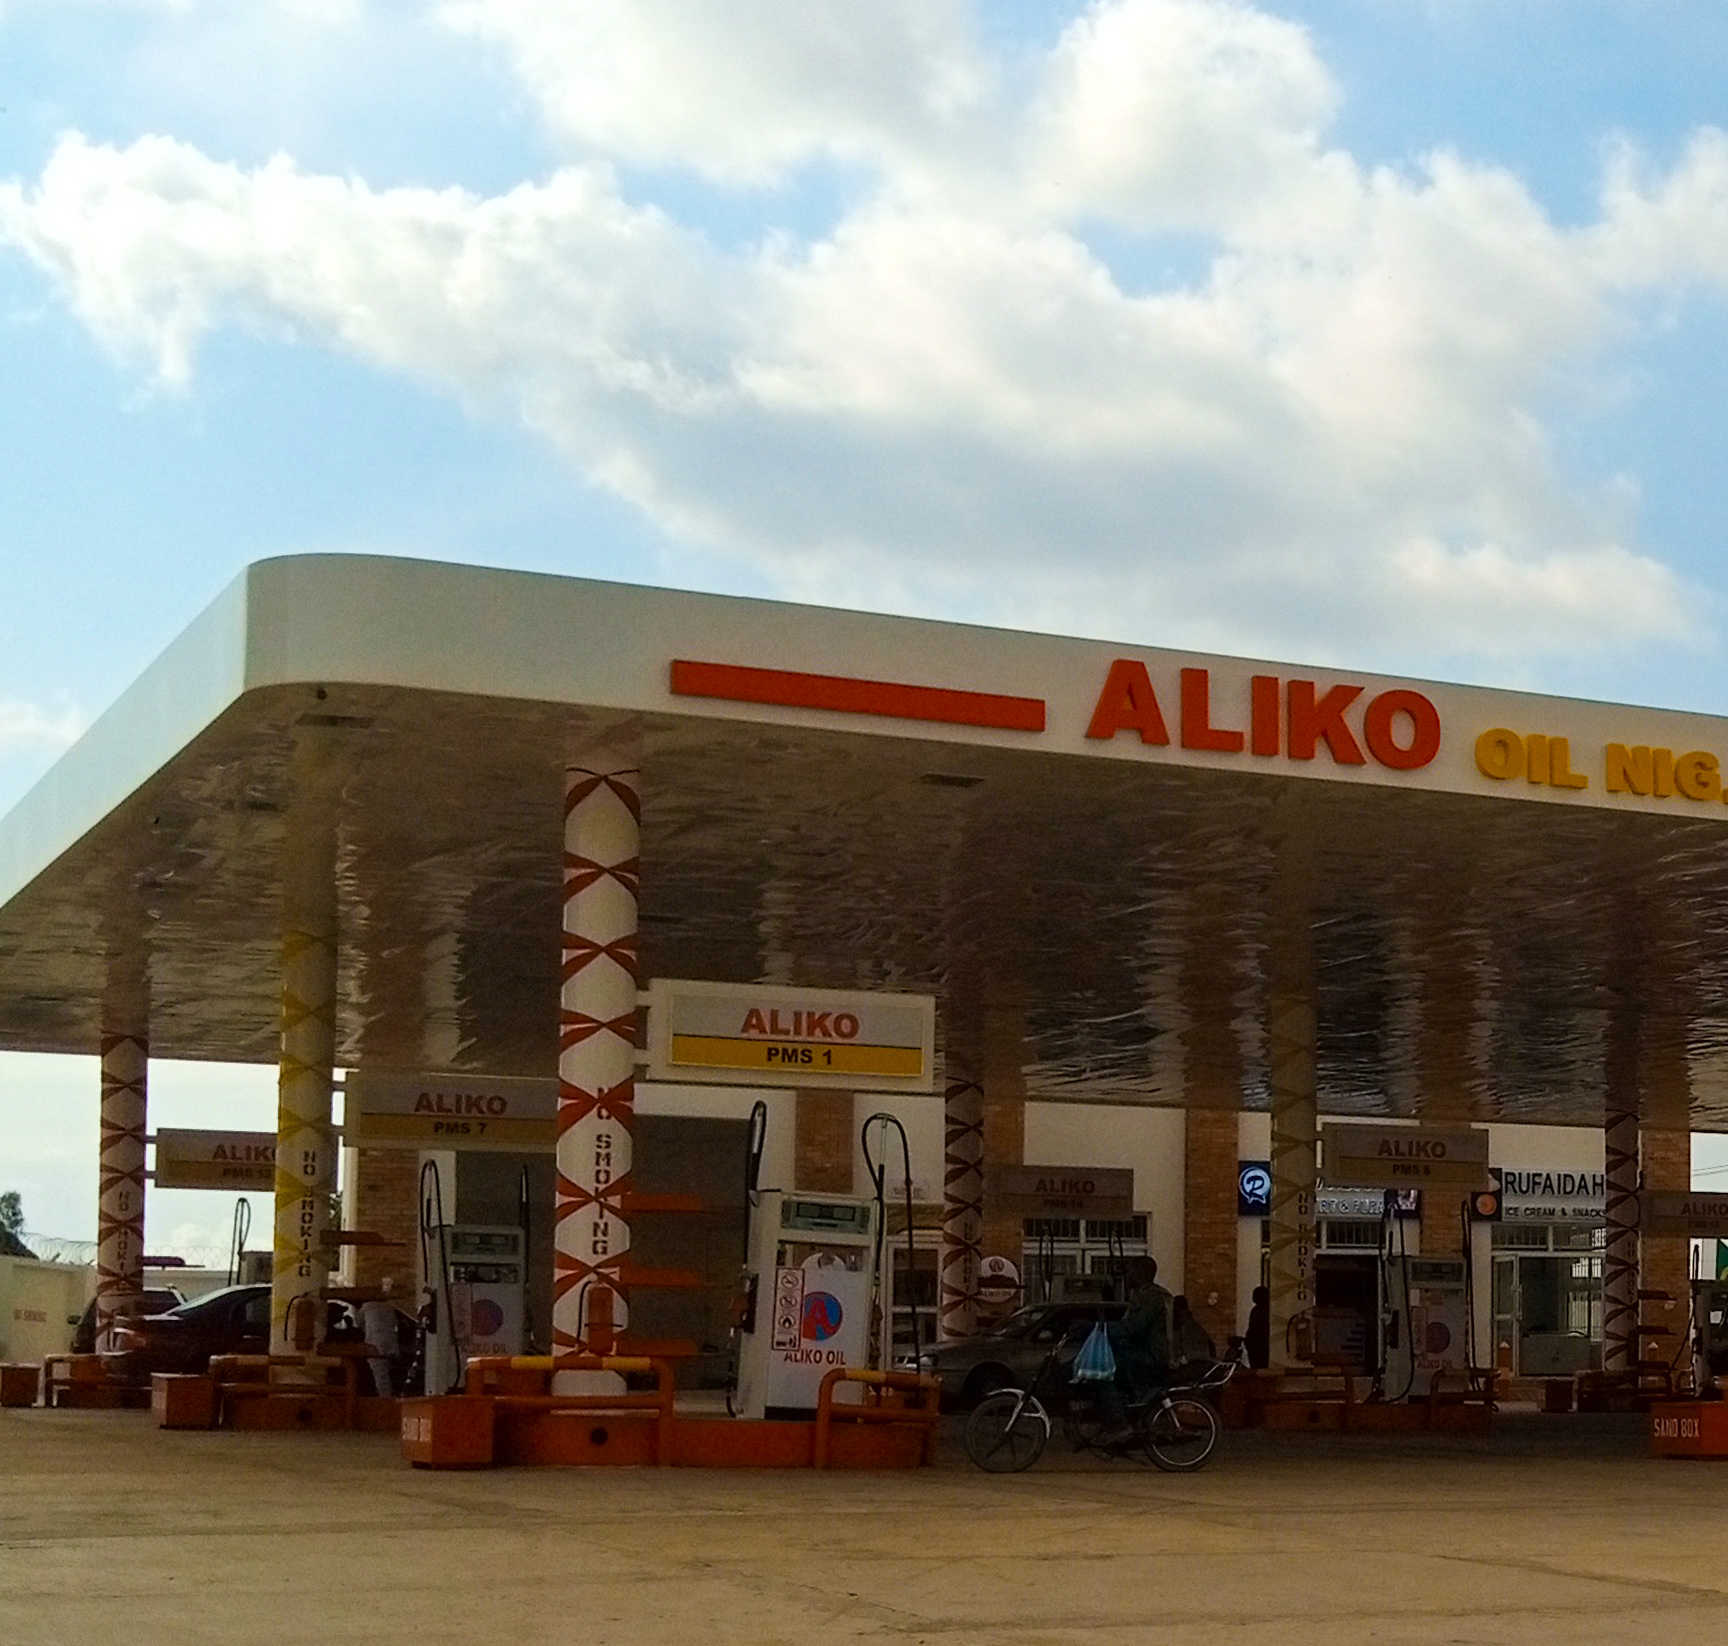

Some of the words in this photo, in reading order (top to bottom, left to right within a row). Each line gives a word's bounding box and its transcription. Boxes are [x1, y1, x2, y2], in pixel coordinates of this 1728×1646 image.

[1085, 658, 1440, 770] ALIKO
[1475, 728, 1588, 789] OIL
[740, 1008, 861, 1039] ALIKO
[767, 1047, 813, 1064] PMS
[823, 1049, 833, 1065] 1
[414, 1091, 508, 1116] ALIKO
[597, 1087, 612, 1120] O
[434, 1121, 471, 1135] PMS
[478, 1122, 488, 1134] 7
[212, 1144, 276, 1161] ALIK
[1377, 1139, 1447, 1158] ALIKO
[303, 1150, 317, 1176] NO
[1393, 1164, 1419, 1176] PMS
[1034, 1178, 1096, 1195] ALIKO
[1504, 1171, 1605, 1196] RUFAIDAH
[1299, 1193, 1309, 1215] NO
[1505, 1206, 1519, 1217] ICE
[1524, 1206, 1555, 1217] CREAM
[1681, 1202, 1728, 1216] ALIKO
[784, 1348, 823, 1364] ALIKO
[826, 1350, 846, 1365] OIL
[1653, 1417, 1679, 1437] SAND
[1680, 1417, 1700, 1438] BOX
